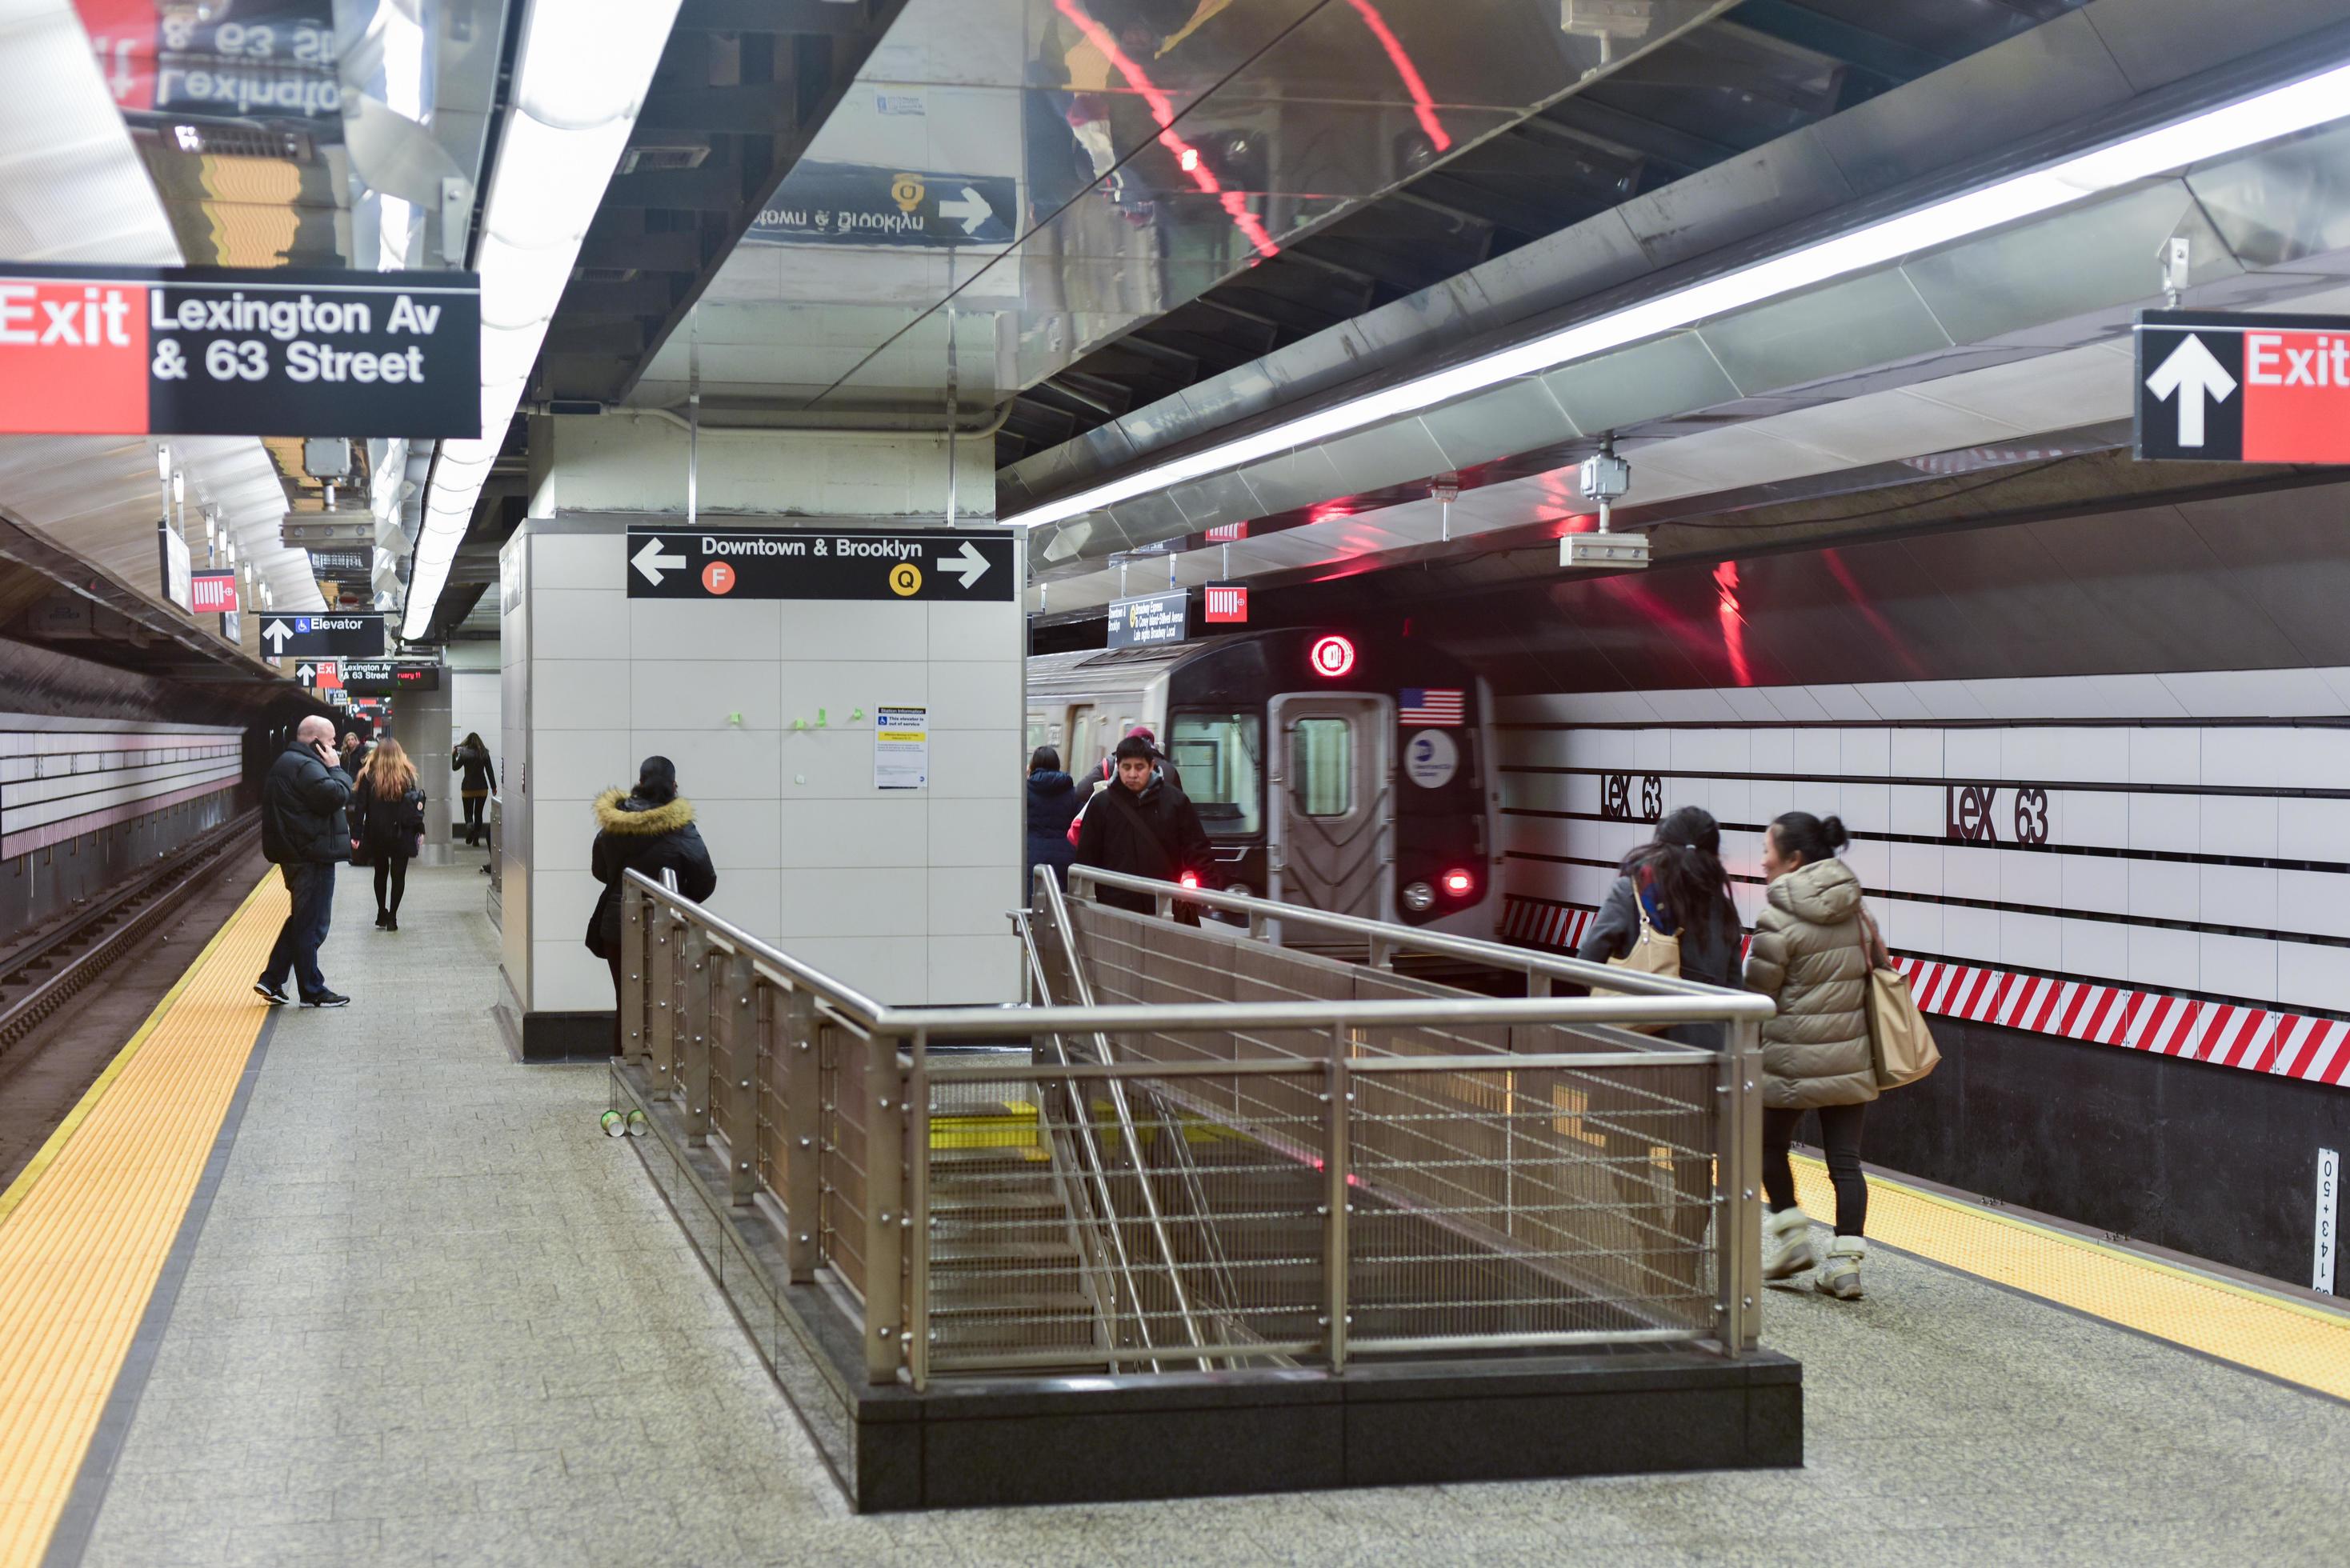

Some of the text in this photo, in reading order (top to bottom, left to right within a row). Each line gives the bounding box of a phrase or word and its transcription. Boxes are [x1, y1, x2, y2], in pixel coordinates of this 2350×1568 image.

[0, 286, 130, 346] Exit
[150, 289, 441, 341] Lexington Av
[152, 338, 425, 383] & 63 Street
[2248, 334, 2350, 386] Exit
[702, 537, 923, 560] Downtown & Brooklyn
[711, 569, 726, 587] F
[898, 570, 915, 589] Q
[310, 618, 363, 630] Elevator
[342, 663, 379, 672] Lexington
[1643, 774, 1662, 819] 63
[2015, 788, 2048, 844] 63
